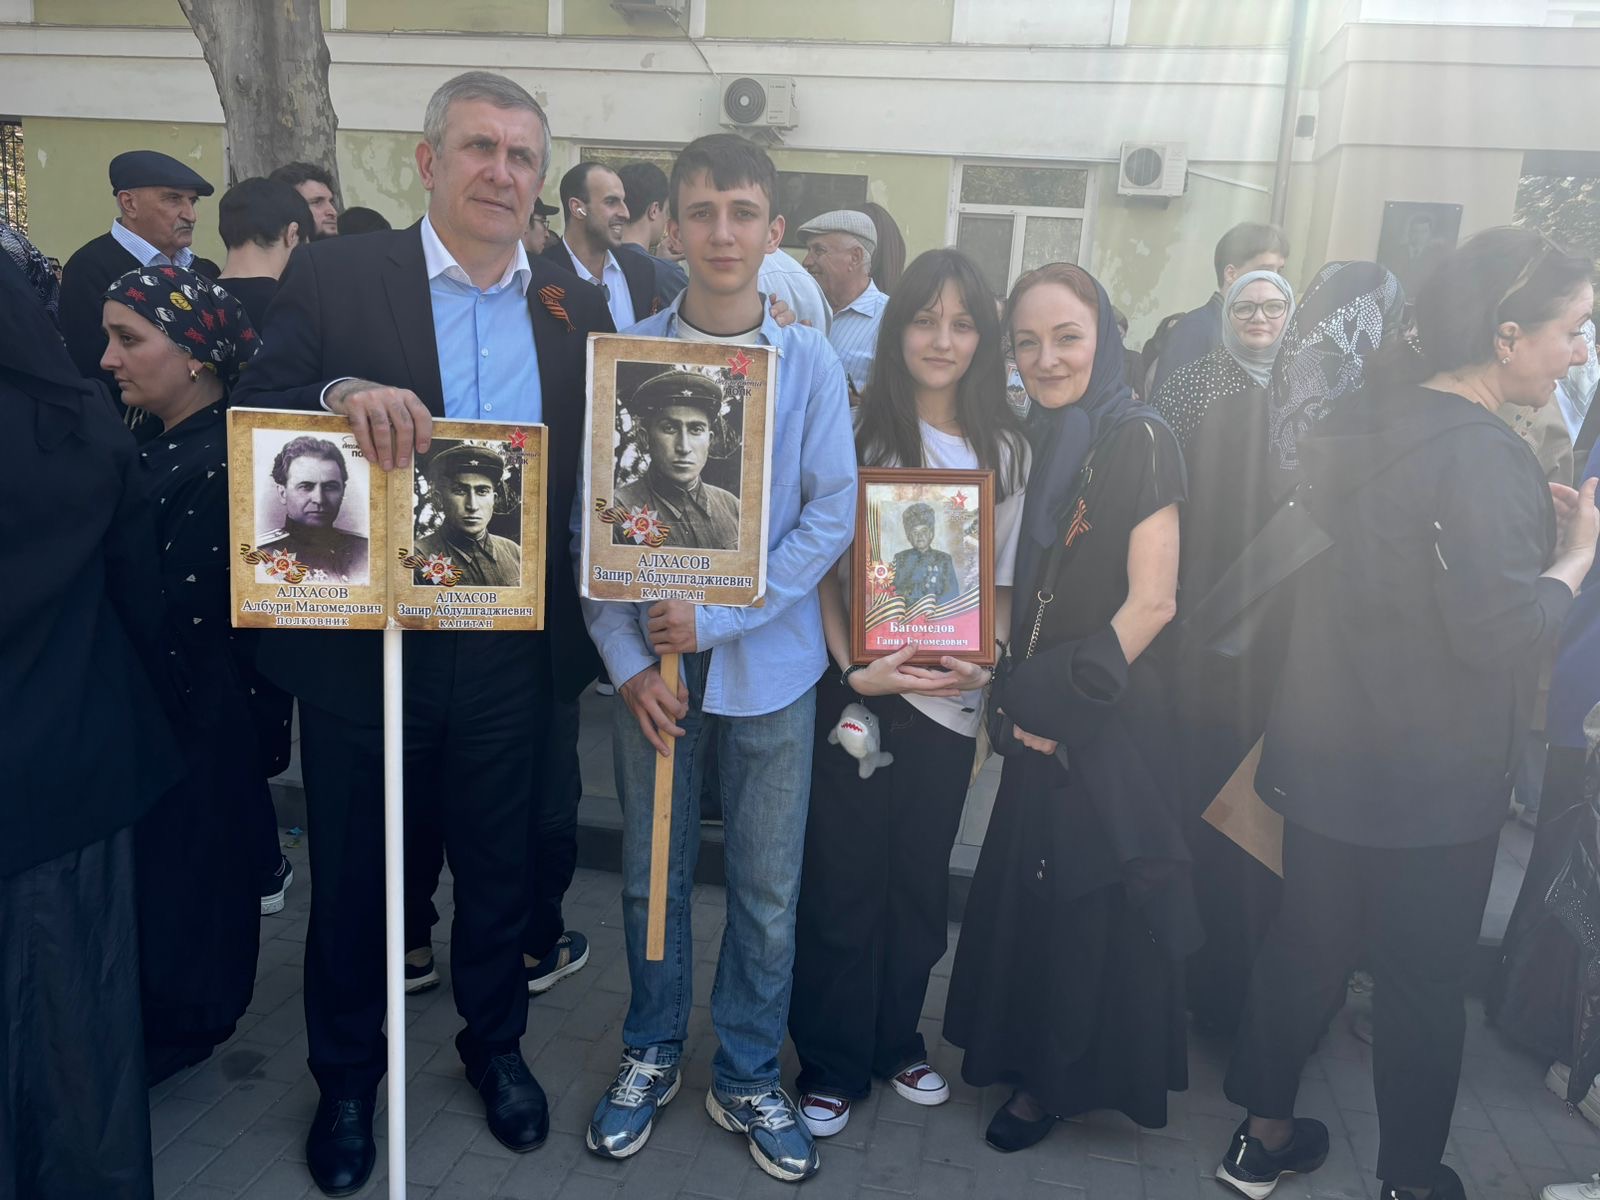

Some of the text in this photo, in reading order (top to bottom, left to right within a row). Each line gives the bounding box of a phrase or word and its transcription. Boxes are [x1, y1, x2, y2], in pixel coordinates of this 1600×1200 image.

[638, 554, 710, 570] АЛХАСОВ
[594, 567, 752, 587] Запир Абдуллгаджиевич
[277, 586, 349, 599] АЛХАСОВ
[436, 592, 497, 604] АЛХАСОВ
[641, 588, 705, 600] КАПИТАН
[242, 600, 382, 614] Албури Магомедович
[398, 604, 533, 617] Запир Абдуллгаджиевич
[439, 619, 494, 628] КАПИТАН
[890, 621, 955, 633] Багомедов
